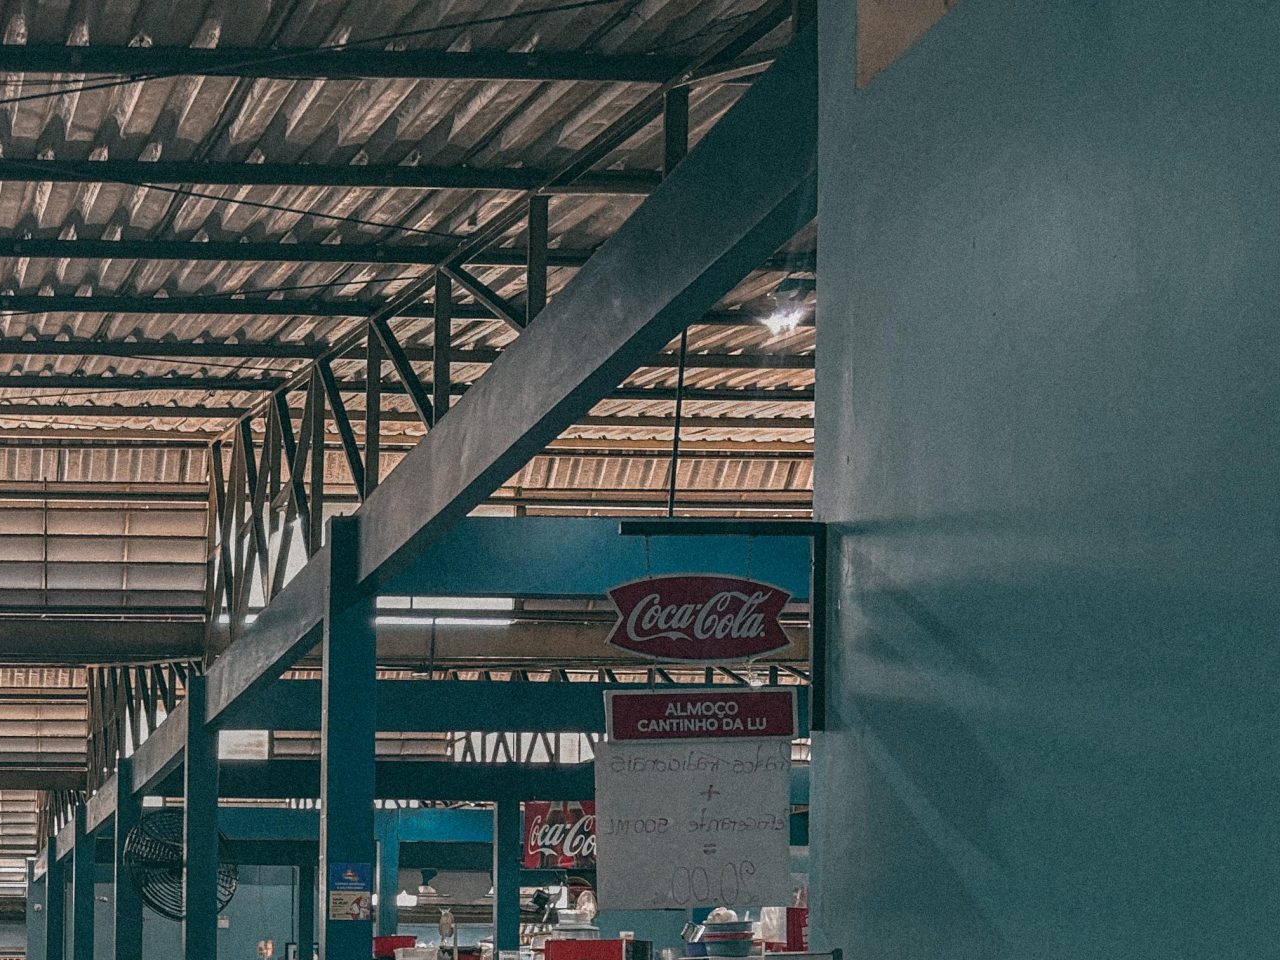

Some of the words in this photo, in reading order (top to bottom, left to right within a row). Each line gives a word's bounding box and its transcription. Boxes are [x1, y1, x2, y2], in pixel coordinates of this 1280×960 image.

[627, 590, 773, 641] Coca-Cola
[637, 719, 718, 731] CANTINHO
[722, 718, 743, 731] DA
[747, 717, 767, 730] LU
[664, 701, 738, 718] ALMOÇO
[528, 815, 597, 857] Coca-Co
